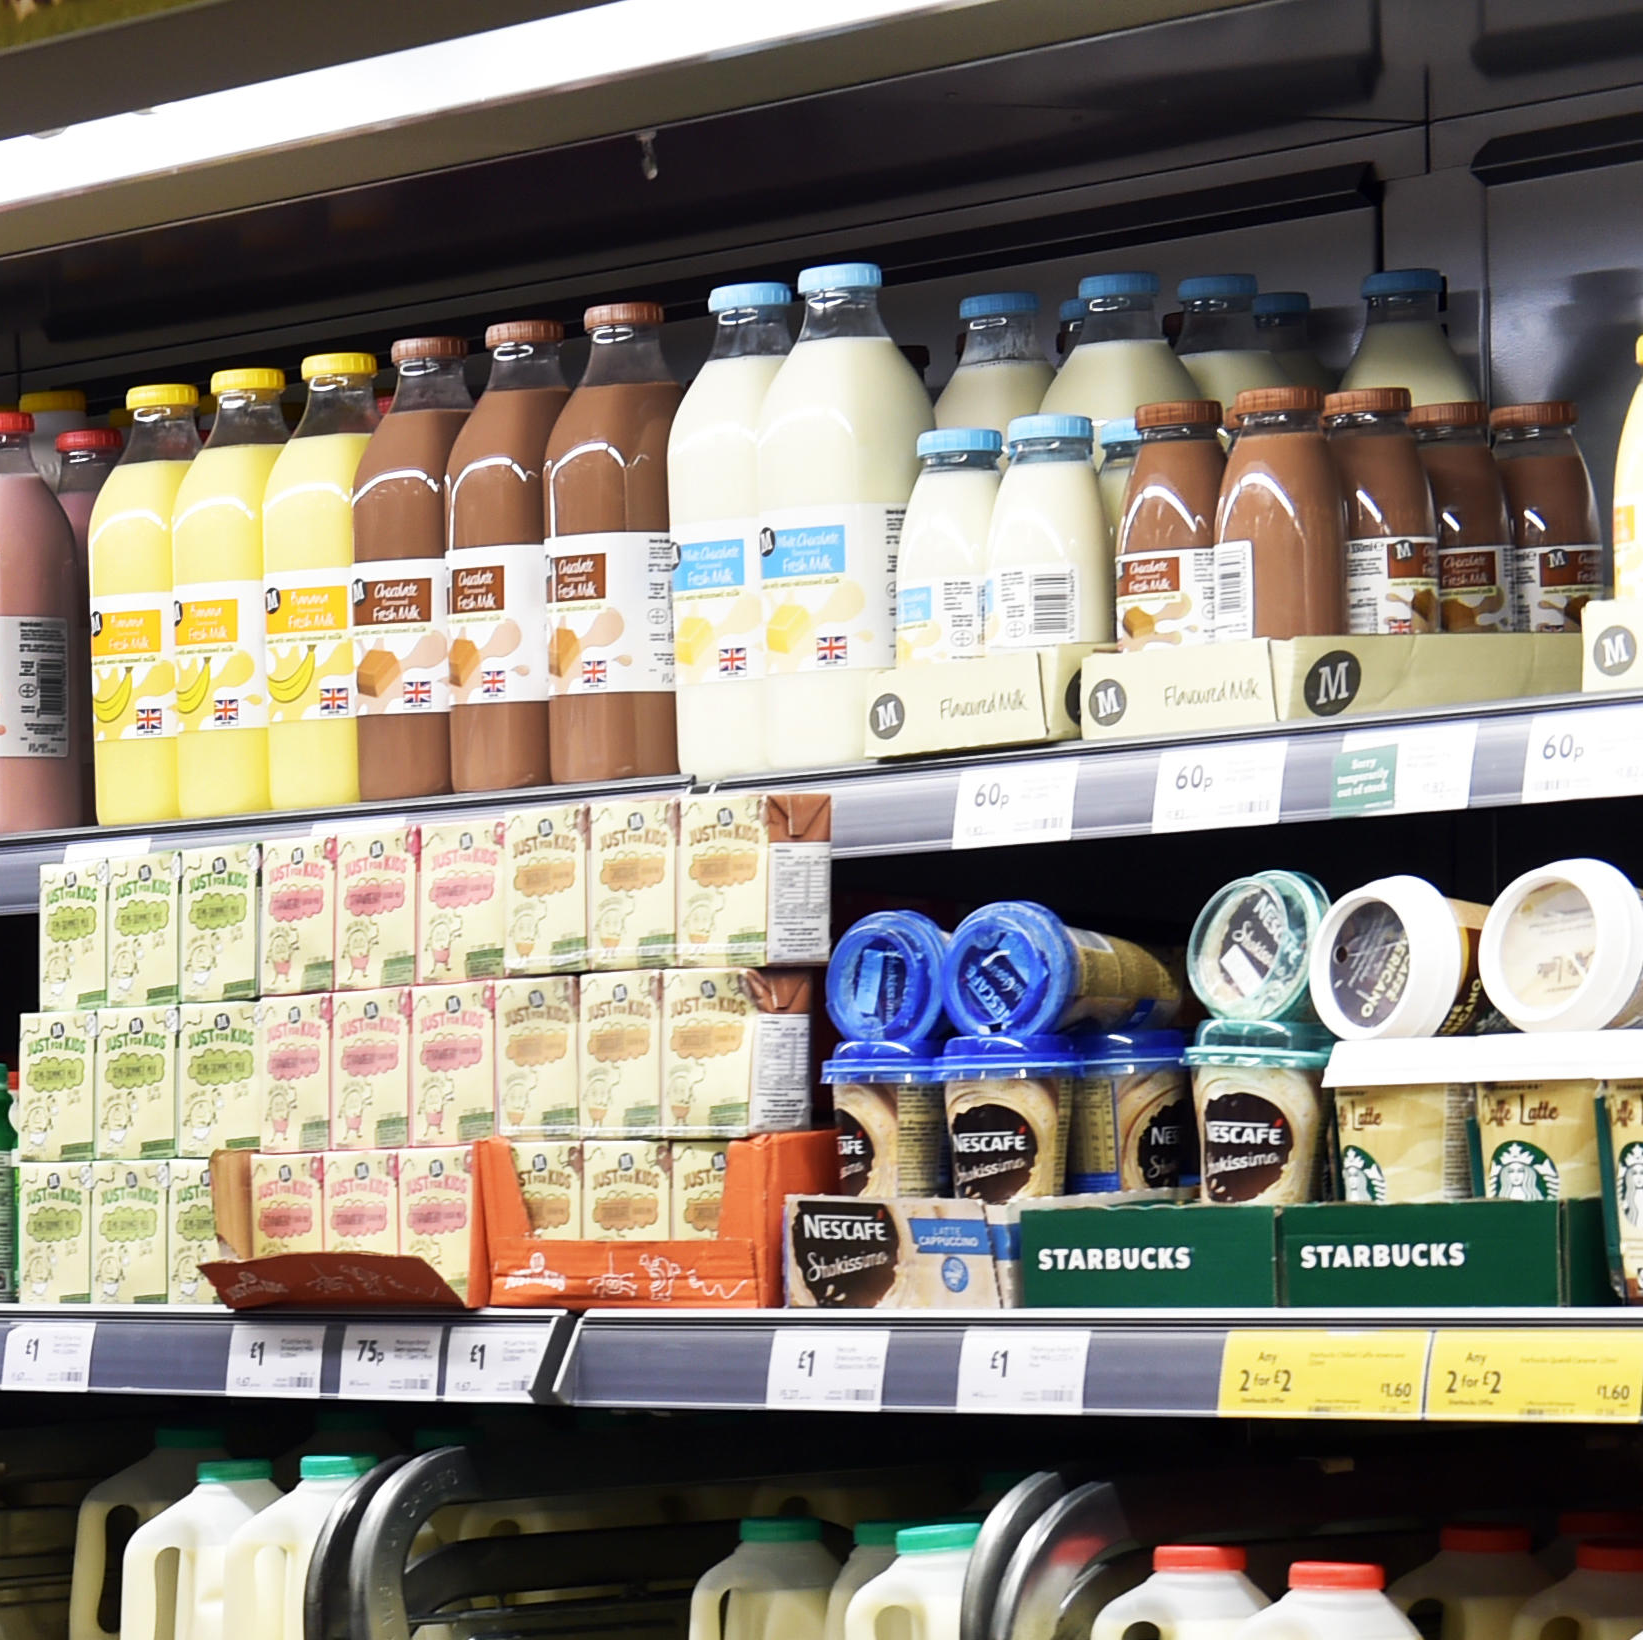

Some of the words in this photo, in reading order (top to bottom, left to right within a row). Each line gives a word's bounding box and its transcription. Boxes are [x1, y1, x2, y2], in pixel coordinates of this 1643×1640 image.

[557, 558, 595, 576] Chocolate
[687, 569, 712, 586] Fresh
[712, 567, 735, 585] Milk
[782, 557, 810, 574] Fresh
[811, 555, 834, 572] Milk
[373, 581, 419, 599] Chocolate
[457, 570, 494, 588] Chocolate
[557, 582, 578, 599] Fresh
[578, 580, 598, 597] Milk
[1128, 580, 1151, 594] Fresh
[1152, 578, 1172, 592] Milk
[1442, 576, 1469, 587] Fresh
[1470, 574, 1489, 585] Milk
[372, 604, 397, 622] Fresh
[398, 602, 421, 621] Milk
[456, 593, 477, 610] Fresh
[478, 592, 497, 608] Milk
[287, 615, 312, 630] Fresh
[313, 610, 337, 628] Milk
[108, 636, 129, 651] Fresh
[130, 632, 151, 649] Milk
[187, 626, 208, 642] Fresh
[209, 623, 229, 640] Milk
[1599, 634, 1631, 666] M
[1164, 684, 1227, 707] Flavoured
[1228, 679, 1261, 702] Milk
[1317, 661, 1350, 702] M
[939, 695, 997, 721] Flavoured
[998, 688, 1029, 713] Milk
[1095, 687, 1122, 716] M
[875, 700, 899, 732] M
[1542, 733, 1585, 762] 60p
[1175, 764, 1214, 793] 60p
[974, 783, 1010, 811] 60p
[1519, 1094, 1560, 1126] Latte
[918, 1234, 978, 1248] CAPPUCCINO
[932, 1225, 962, 1237] LATTE
[807, 1250, 889, 1282] Shakissimo
[1037, 1247, 1191, 1271] STARBUCKS
[1300, 1242, 1466, 1269] STARBUCKS
[25, 1337, 39, 1362] £1
[250, 1341, 264, 1366] £1
[356, 1339, 385, 1366] 75p
[470, 1343, 486, 1370] £1
[1258, 1351, 1277, 1364] Any
[1465, 1351, 1487, 1367] Any
[797, 1349, 816, 1377] £1
[990, 1350, 1010, 1378] £1
[1238, 1369, 1251, 1393] 2
[1253, 1373, 1270, 1387] for
[1273, 1368, 1292, 1393] £2
[1445, 1370, 1458, 1394] 2
[1461, 1374, 1479, 1388] for
[1481, 1370, 1502, 1394] £2
